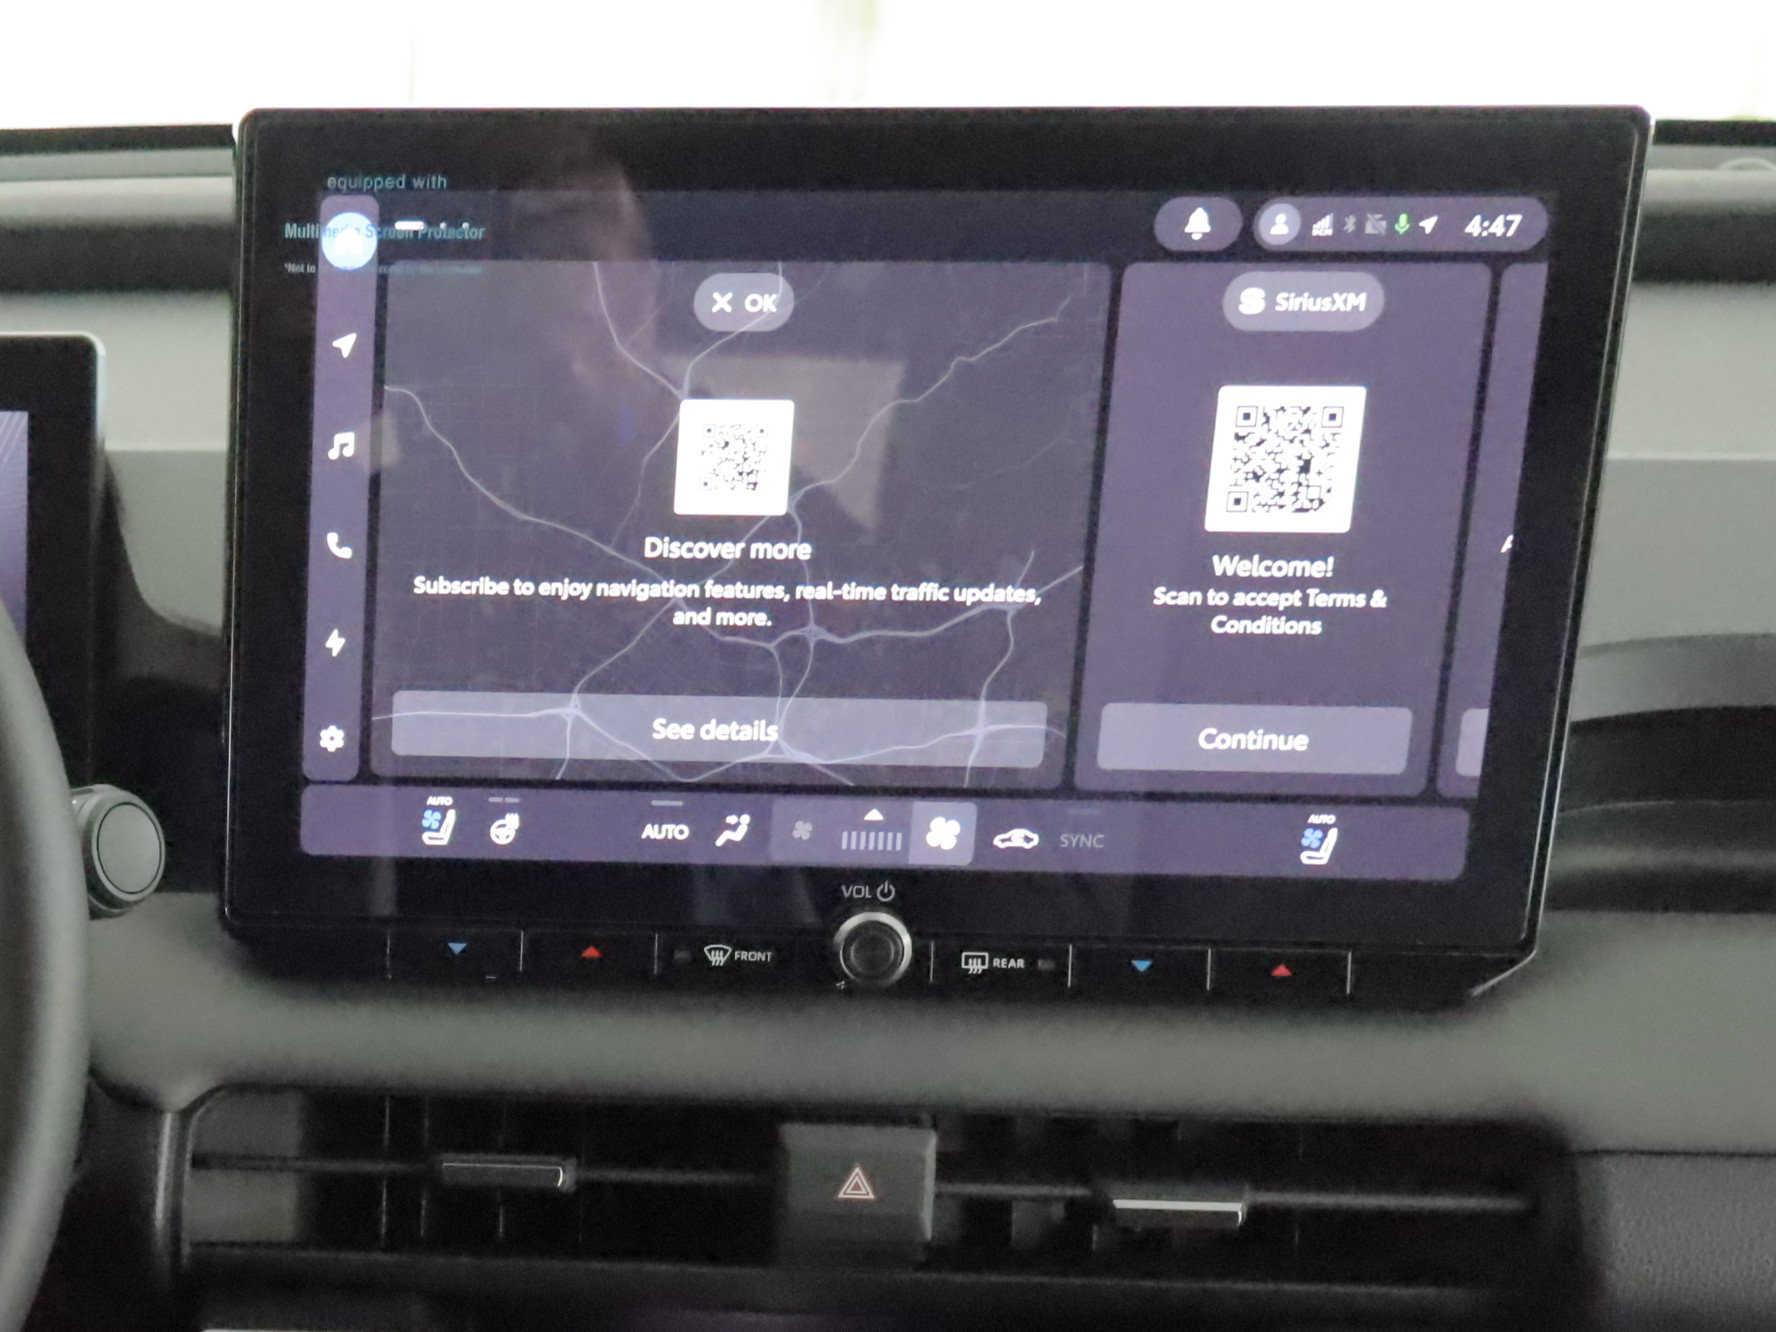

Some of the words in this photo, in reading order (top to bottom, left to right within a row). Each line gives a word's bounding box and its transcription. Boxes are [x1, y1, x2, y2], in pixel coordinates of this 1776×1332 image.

[326, 173, 406, 191] equipped
[412, 174, 448, 190] with
[1464, 213, 1523, 237] 4:47
[744, 293, 778, 313] OK
[1274, 291, 1367, 312] SiriusXM
[644, 536, 746, 559] Discover
[750, 541, 812, 560] more
[1212, 554, 1335, 579] Welcome!
[413, 575, 510, 595] Subscribe
[513, 578, 535, 596] to
[538, 577, 593, 601] enjoy
[596, 578, 700, 602] navigation
[704, 579, 791, 602] features,
[795, 581, 887, 601] real-time
[891, 582, 949, 602] traffic
[953, 583, 1042, 606] updates,
[1153, 586, 1203, 607] Scan
[1207, 588, 1230, 607] to
[1233, 590, 1303, 611] accept
[1306, 588, 1367, 609] Terms
[1370, 589, 1388, 609] &
[672, 607, 711, 626] and
[715, 610, 773, 627] more.
[1210, 615, 1323, 636] Conditions
[652, 718, 695, 740] See
[699, 718, 779, 742] details
[1198, 727, 1310, 753] Continue
[426, 796, 453, 806] AUTO
[1307, 813, 1337, 825] AUTO
[641, 823, 690, 840] AUTO
[1059, 833, 1105, 849] SYNC
[841, 884, 872, 899] VOL
[734, 950, 773, 963] FRONT
[992, 956, 1025, 970] REAR
